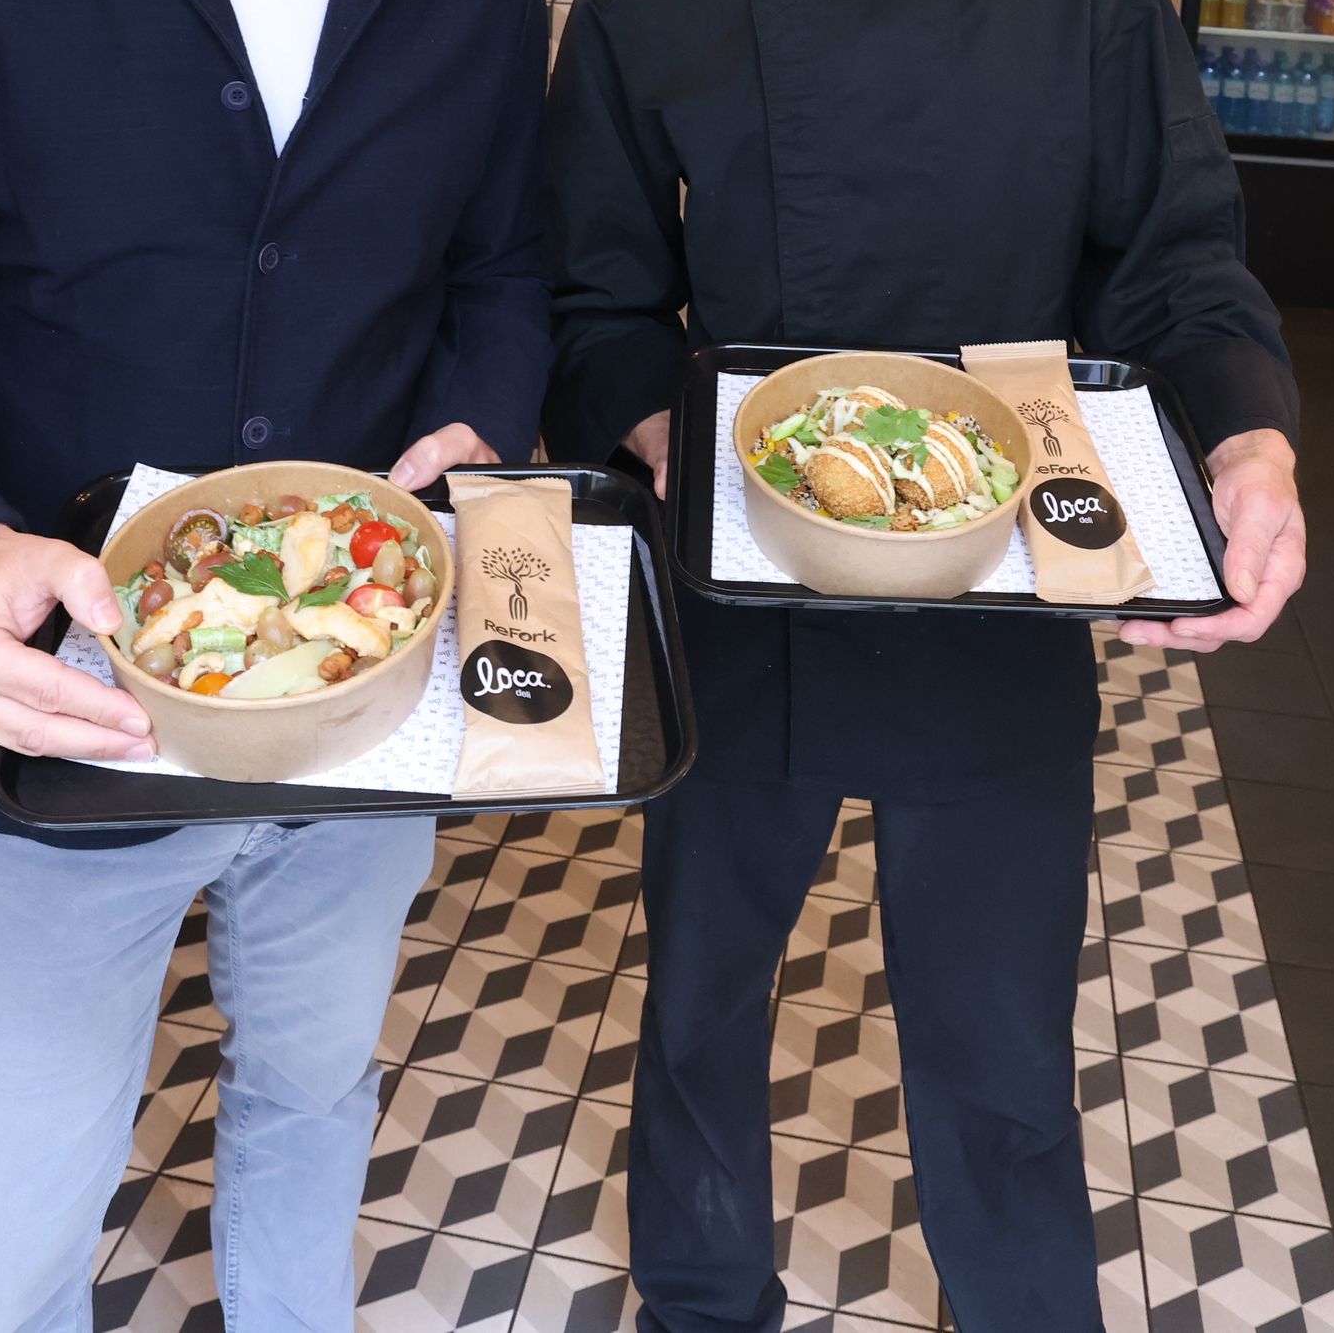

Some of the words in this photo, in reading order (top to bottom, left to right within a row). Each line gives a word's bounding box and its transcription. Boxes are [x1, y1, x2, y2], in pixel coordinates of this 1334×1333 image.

[1035, 463, 1092, 475] eFork
[484, 618, 558, 643] ReFork
[515, 688, 532, 700] deli
